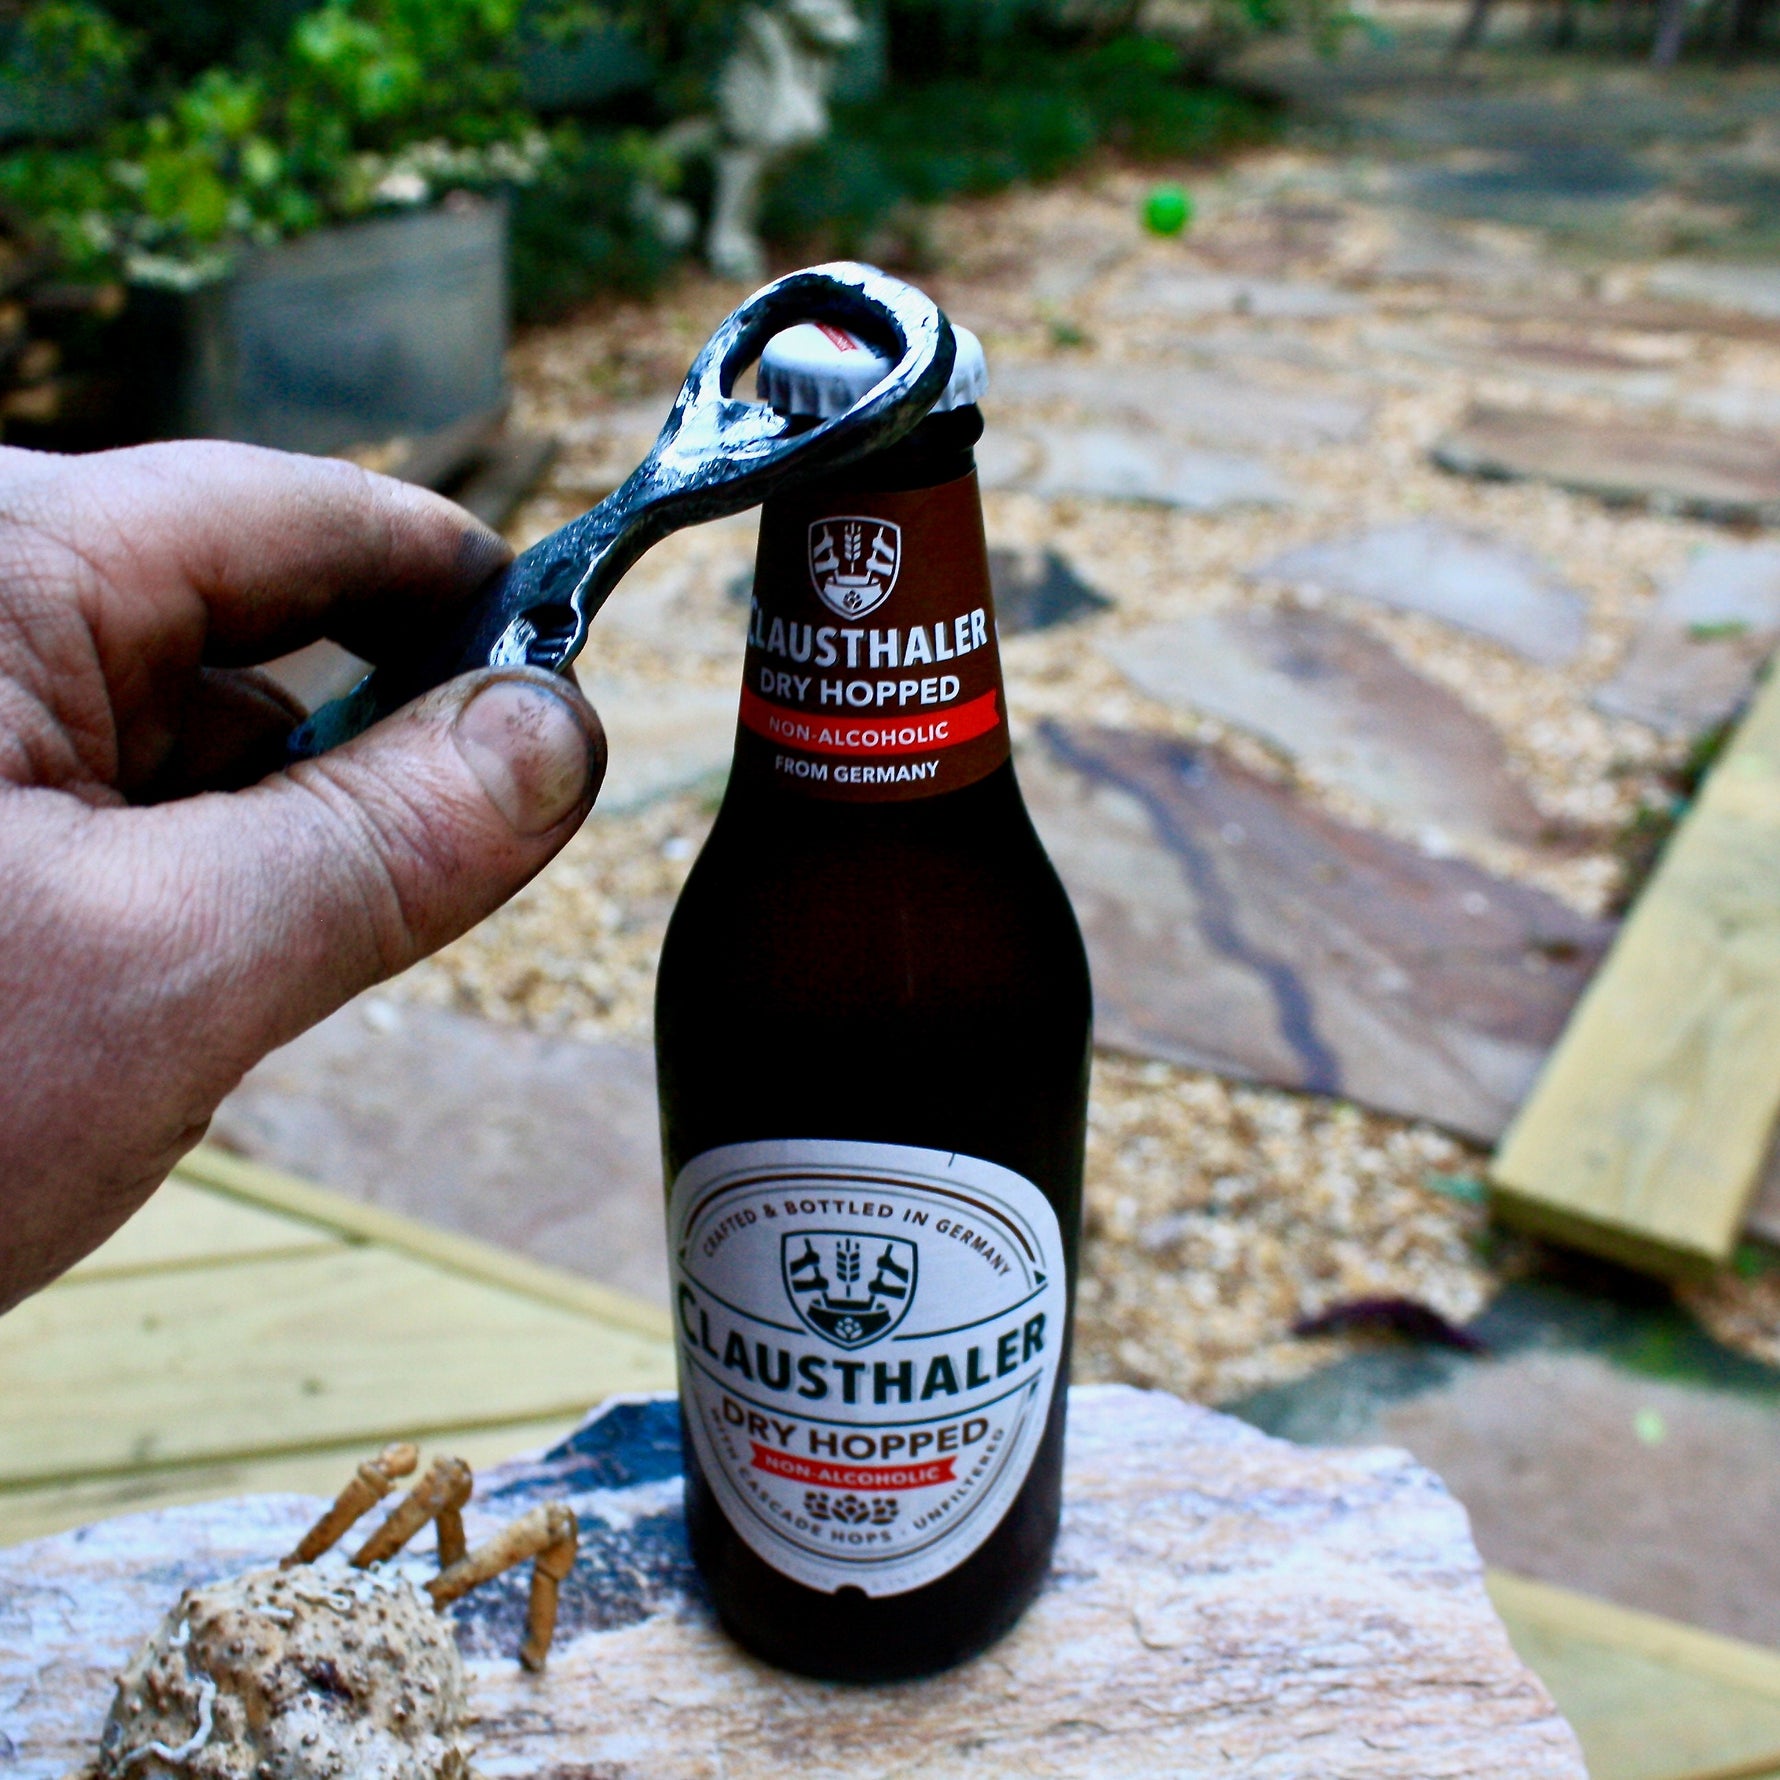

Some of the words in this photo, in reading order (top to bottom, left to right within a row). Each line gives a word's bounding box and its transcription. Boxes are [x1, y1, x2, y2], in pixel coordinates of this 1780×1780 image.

[760, 667, 812, 701] DRY
[820, 675, 960, 707] HOPPED
[769, 716, 949, 747] NON-ALCOHOLIC
[775, 755, 828, 782] FROM
[833, 760, 939, 783] GERMANY
[703, 1209, 757, 1257] CRAFTED
[763, 1203, 777, 1218] &
[784, 1201, 893, 1218] BOTTLED
[903, 1208, 929, 1226] IN
[936, 1219, 1012, 1276] GERMANY
[678, 1282, 1047, 1404] CLAUSTHALER
[723, 1396, 797, 1446] DRY
[809, 1418, 989, 1460] HOPPED
[765, 1455, 941, 1486] NON-ALCOHOLIC
[830, 1530, 892, 1545] HOPS
[913, 1428, 1004, 1530] UNFILTERED
